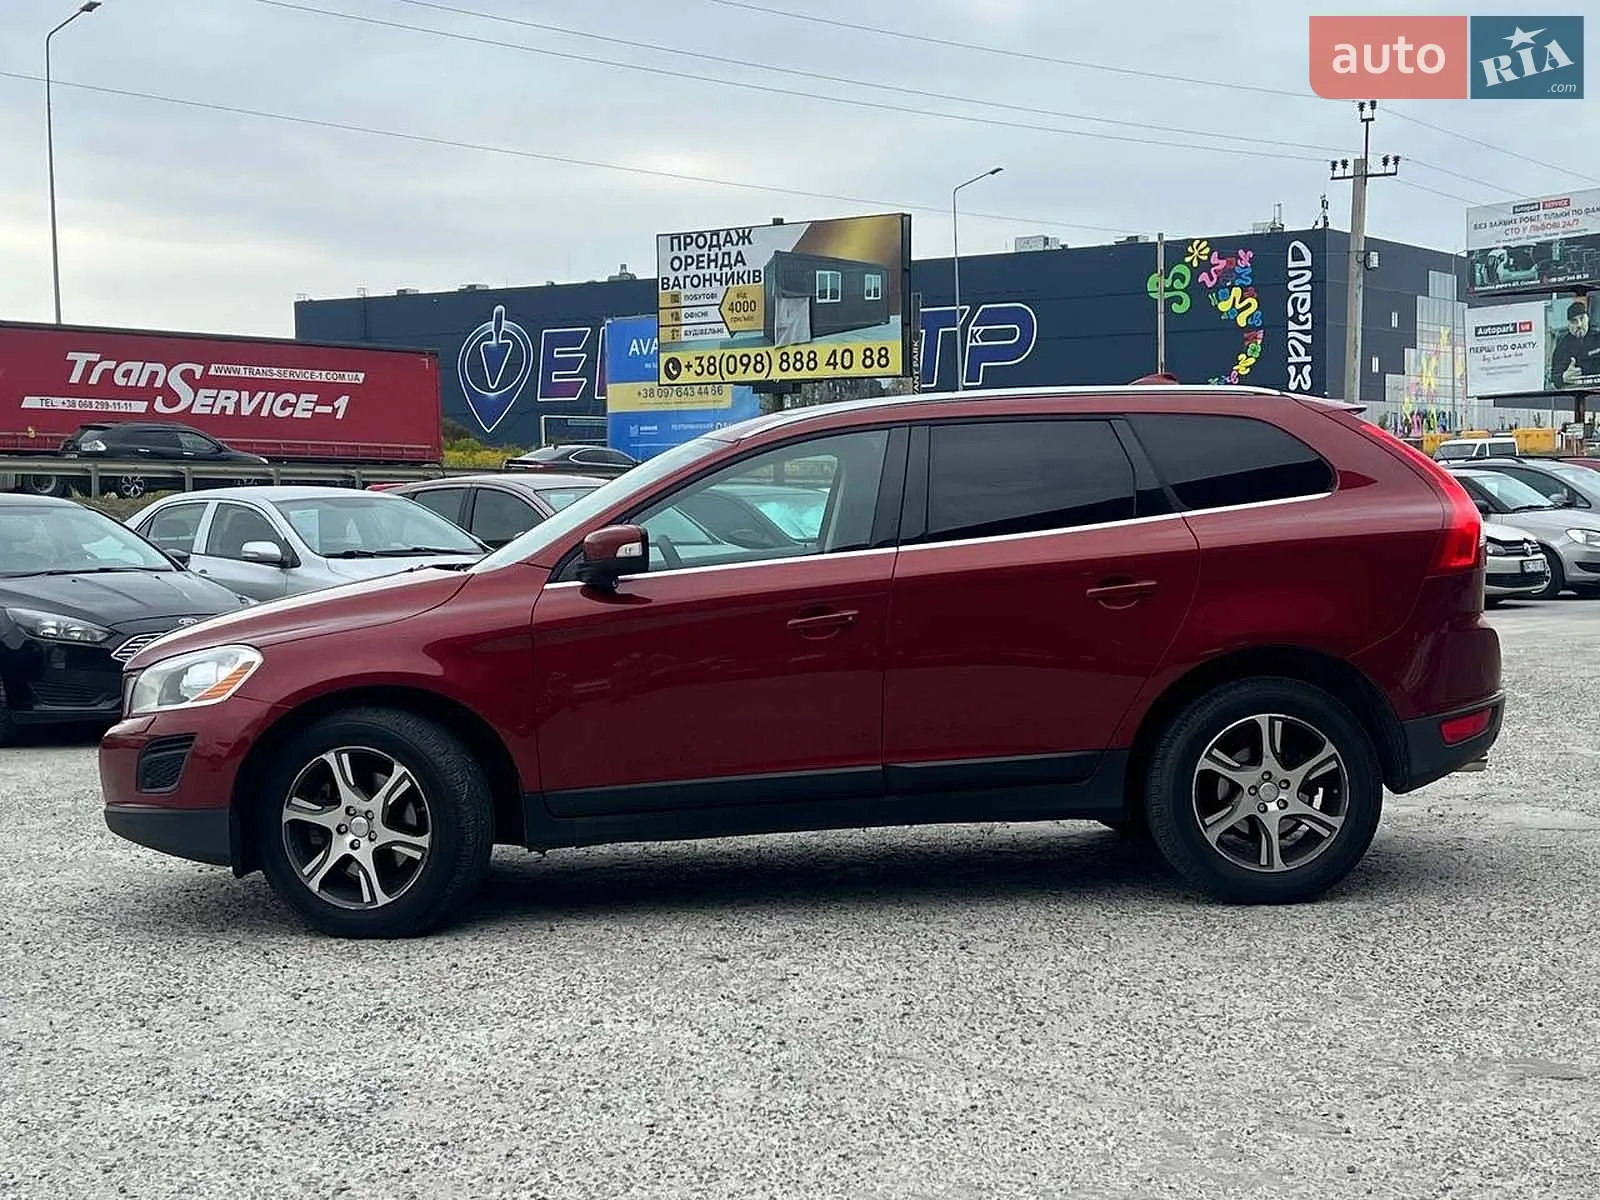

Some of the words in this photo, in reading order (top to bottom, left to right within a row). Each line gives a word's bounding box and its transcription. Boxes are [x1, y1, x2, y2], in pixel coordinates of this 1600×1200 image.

[670, 229, 753, 252] ПРОДАЖ
[670, 250, 746, 272] ОРЕНДА
[661, 269, 762, 291] ВАГОНЧИКІВ
[728, 300, 757, 314] 4000
[1497, 343, 1509, 352] ПО
[214, 365, 361, 383] WWW.TRANS-SERVICE-1.COM.UA
[684, 350, 772, 380] +38(098)
[779, 350, 818, 373] 888
[825, 347, 854, 370] 40
[861, 346, 890, 370] 88
